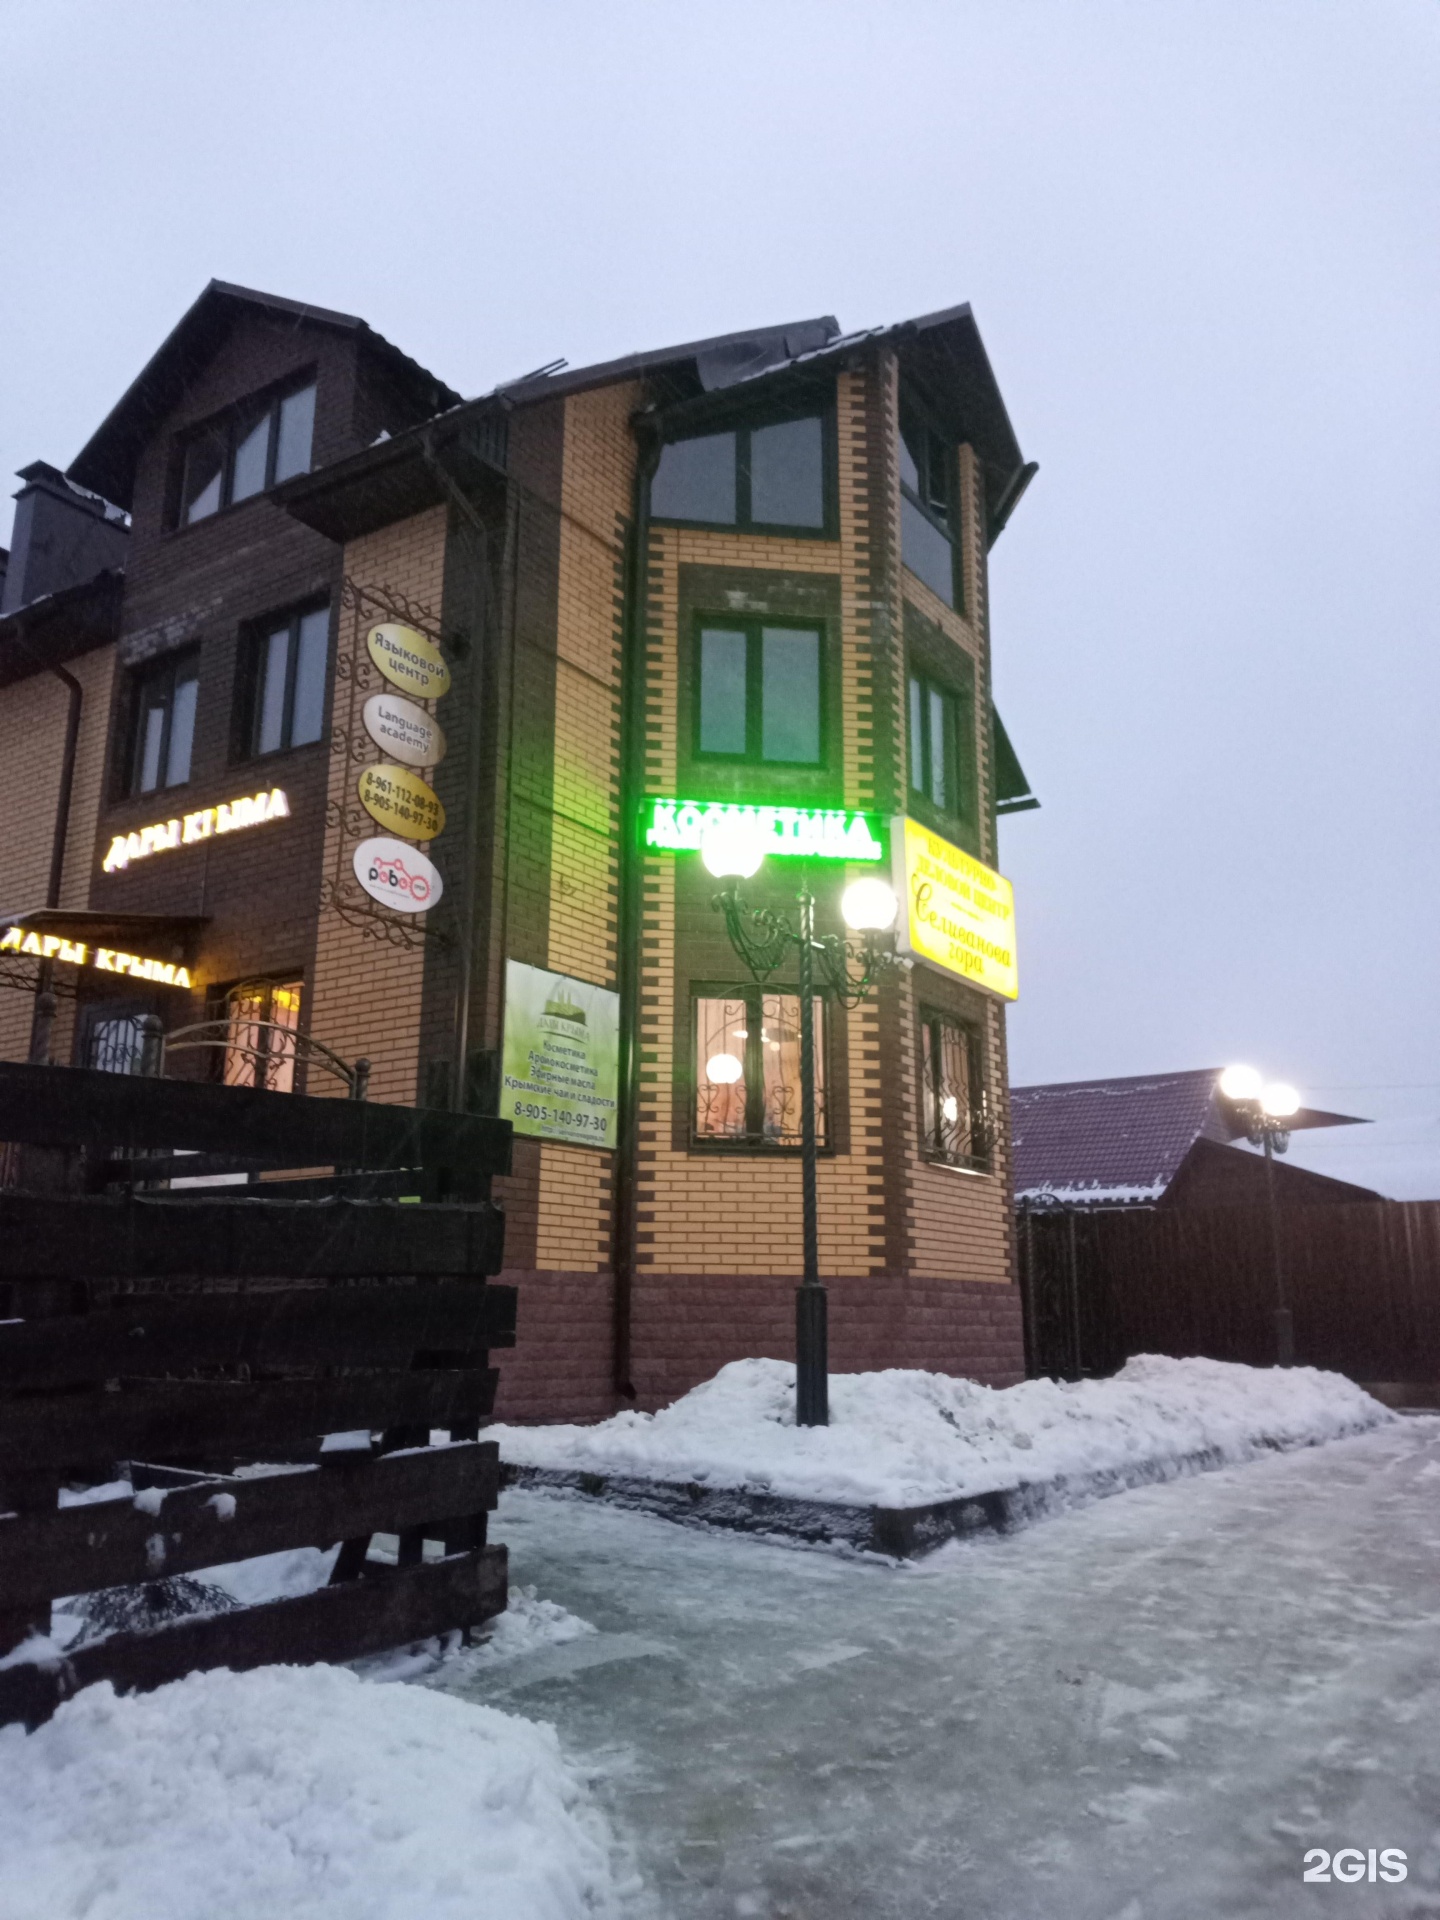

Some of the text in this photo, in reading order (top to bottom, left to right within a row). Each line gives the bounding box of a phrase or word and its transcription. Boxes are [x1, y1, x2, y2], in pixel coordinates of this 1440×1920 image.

[373, 632, 445, 678] Языковой
[388, 656, 430, 686] центр
[378, 705, 433, 740] Language
[379, 723, 430, 753] academy
[364, 789, 438, 832] 8-905-140-97-30
[103, 819, 182, 872] ДАРЫ
[911, 873, 1011, 968] Селиванова
[95, 947, 192, 989] КРЫМА
[949, 942, 984, 975] гора
[543, 1039, 586, 1060] Косметика
[504, 1075, 552, 1095] Крымские
[577, 1093, 615, 1108] сладости
[530, 1065, 570, 1085] Эфирные
[513, 1101, 608, 1131] 8-905-140-97-30
